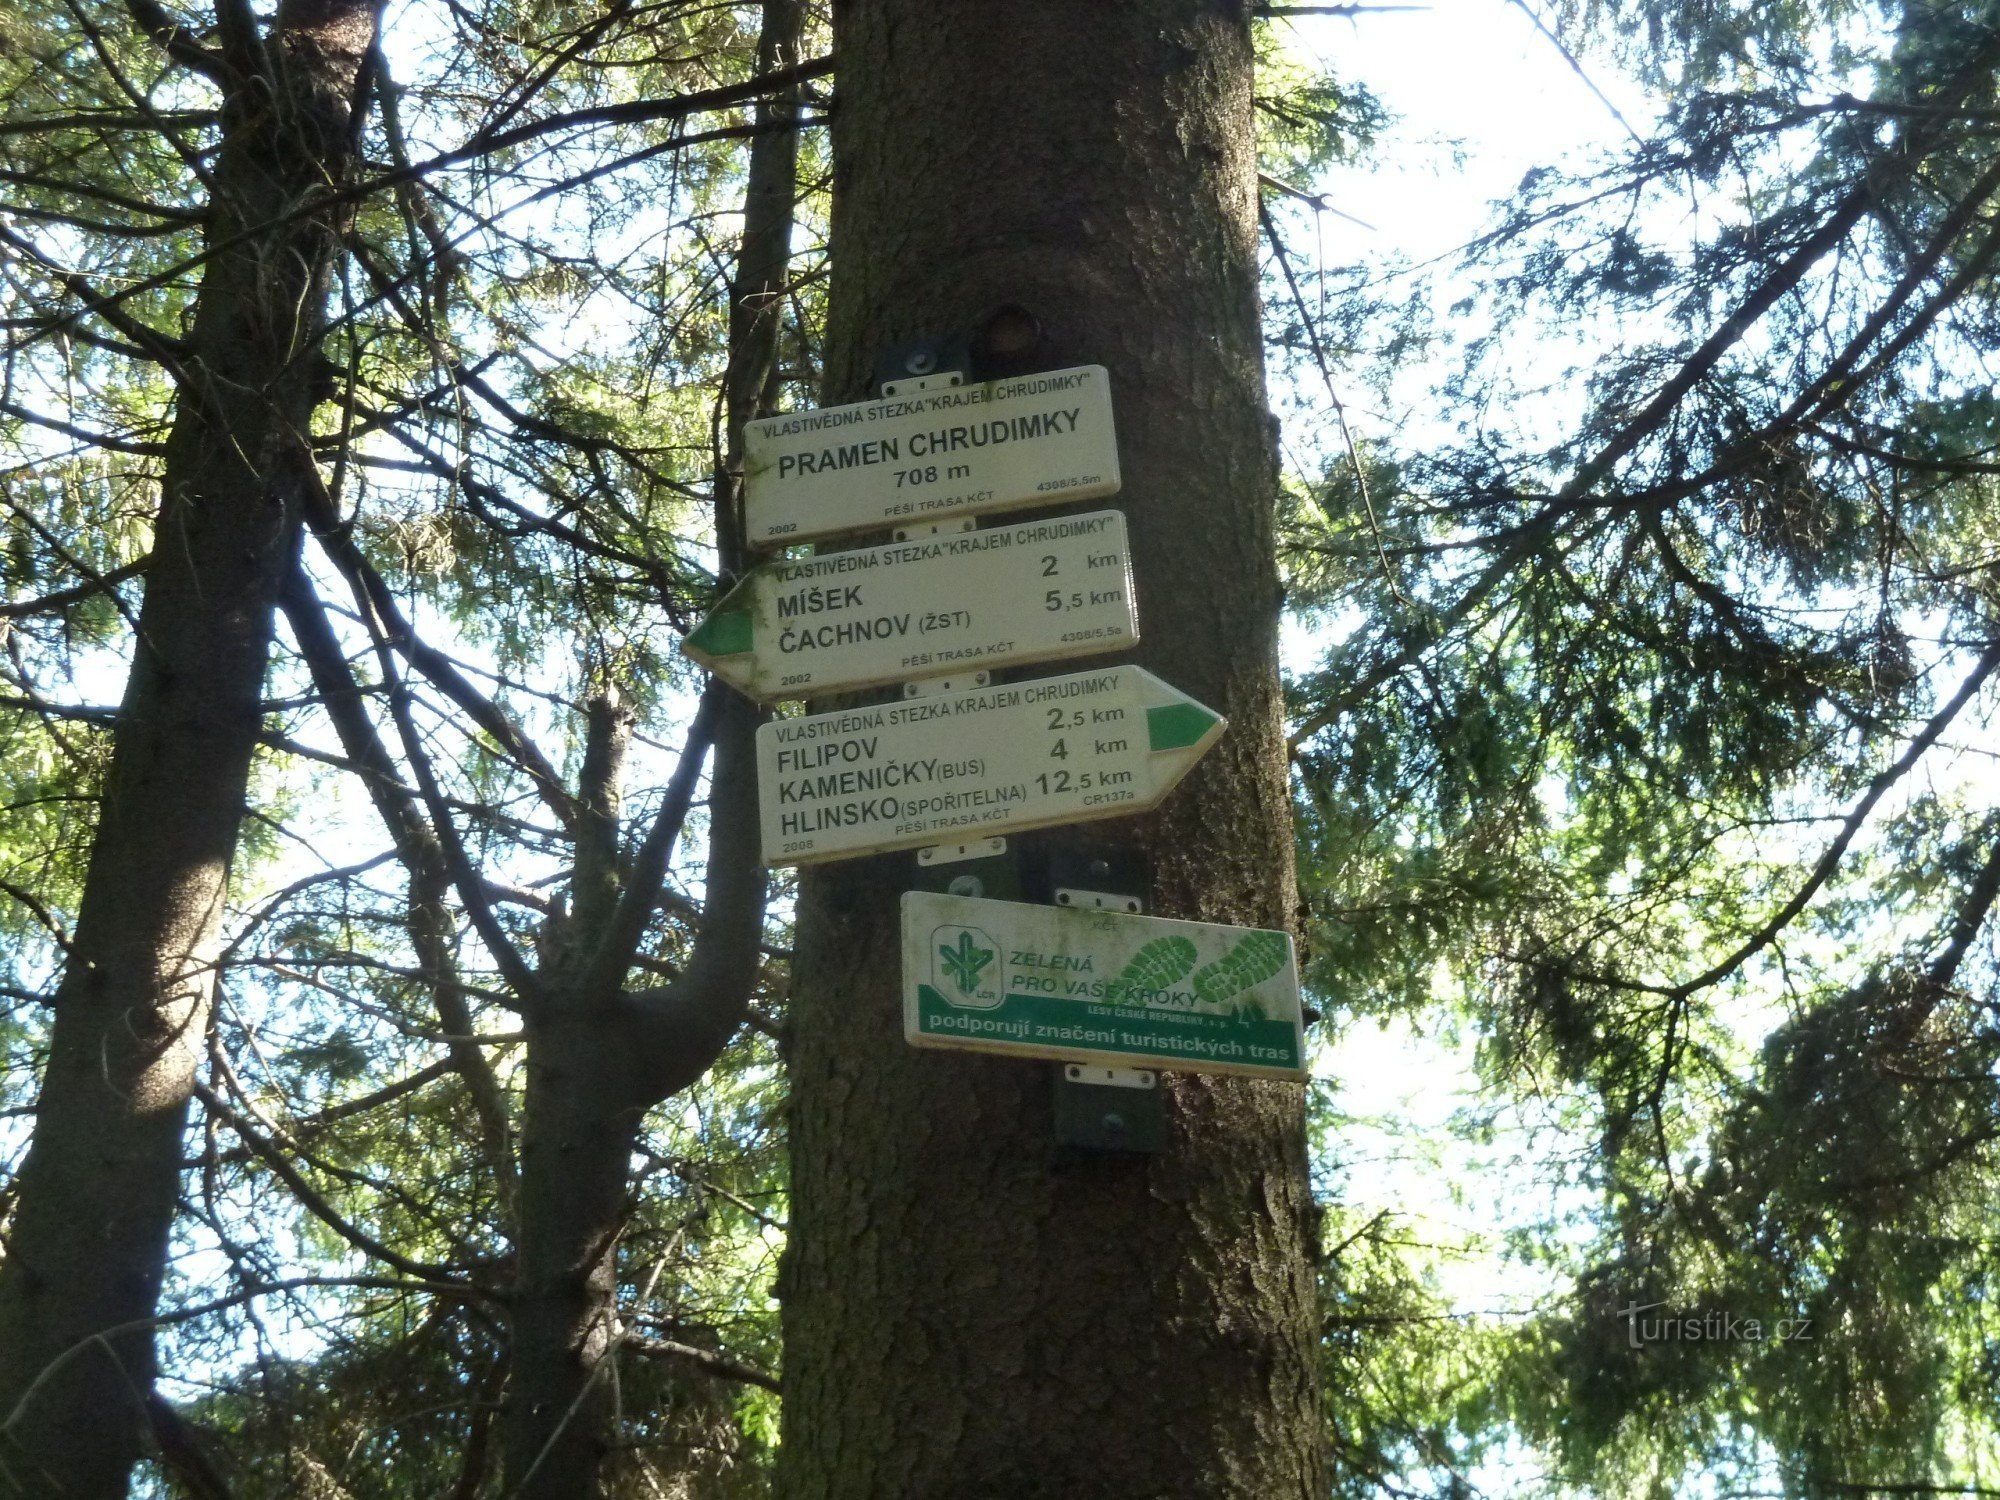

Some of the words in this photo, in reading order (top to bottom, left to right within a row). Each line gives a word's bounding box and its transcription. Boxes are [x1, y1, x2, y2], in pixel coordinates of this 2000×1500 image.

[763, 406, 863, 439] VLASTIVĚDNÁ
[868, 400, 925, 421] STEZKA
[778, 438, 899, 479] PRAMEN
[908, 408, 1081, 457] CHRUDIMKY
[893, 466, 938, 488] 708
[948, 464, 970, 480] m
[919, 495, 963, 512] TRASA
[967, 490, 994, 504] KČT
[768, 523, 797, 536] 2002
[775, 552, 879, 583] VLASTIVĚDNÁ
[883, 544, 942, 566] STEZKA
[777, 584, 864, 619] MÍŠEK
[1041, 555, 1059, 577] 2
[1087, 553, 1118, 569] km
[779, 613, 911, 654] ČACHNOV
[918, 610, 971, 635] (ŽST)
[1045, 590, 1083, 612] 5,5
[1089, 590, 1122, 606] km
[938, 646, 983, 662] TRASA
[986, 641, 1015, 654] KČT
[781, 673, 812, 686] 2002
[776, 711, 885, 743] VLASTIVĚDNÁ
[889, 703, 951, 726] STEZKA
[955, 691, 1020, 715] KRAJEM
[1024, 674, 1119, 704] CHRUDIMKY
[777, 736, 878, 773] FILIPOV
[1046, 707, 1085, 731] 2,5
[1092, 708, 1125, 724] km
[1050, 737, 1069, 760] 4
[1094, 738, 1128, 754] km
[1034, 770, 1092, 795] 12,5
[1099, 770, 1132, 786] km
[1083, 791, 1135, 806] CR137a
[931, 812, 978, 830] TRASA
[982, 807, 1011, 821] KČT
[783, 840, 814, 853] 2008
[1009, 950, 1094, 973] ZELENÁ
[1011, 974, 1057, 993] PRO
[1063, 977, 1117, 999] VAŠE
[1124, 986, 1200, 1008] KROKY
[1087, 1005, 1112, 1016] LESY
[929, 1012, 1030, 1038] podporují
[1035, 1023, 1116, 1045] značení
[1121, 1032, 1243, 1057] turistických
[1249, 1045, 1290, 1060] tras
